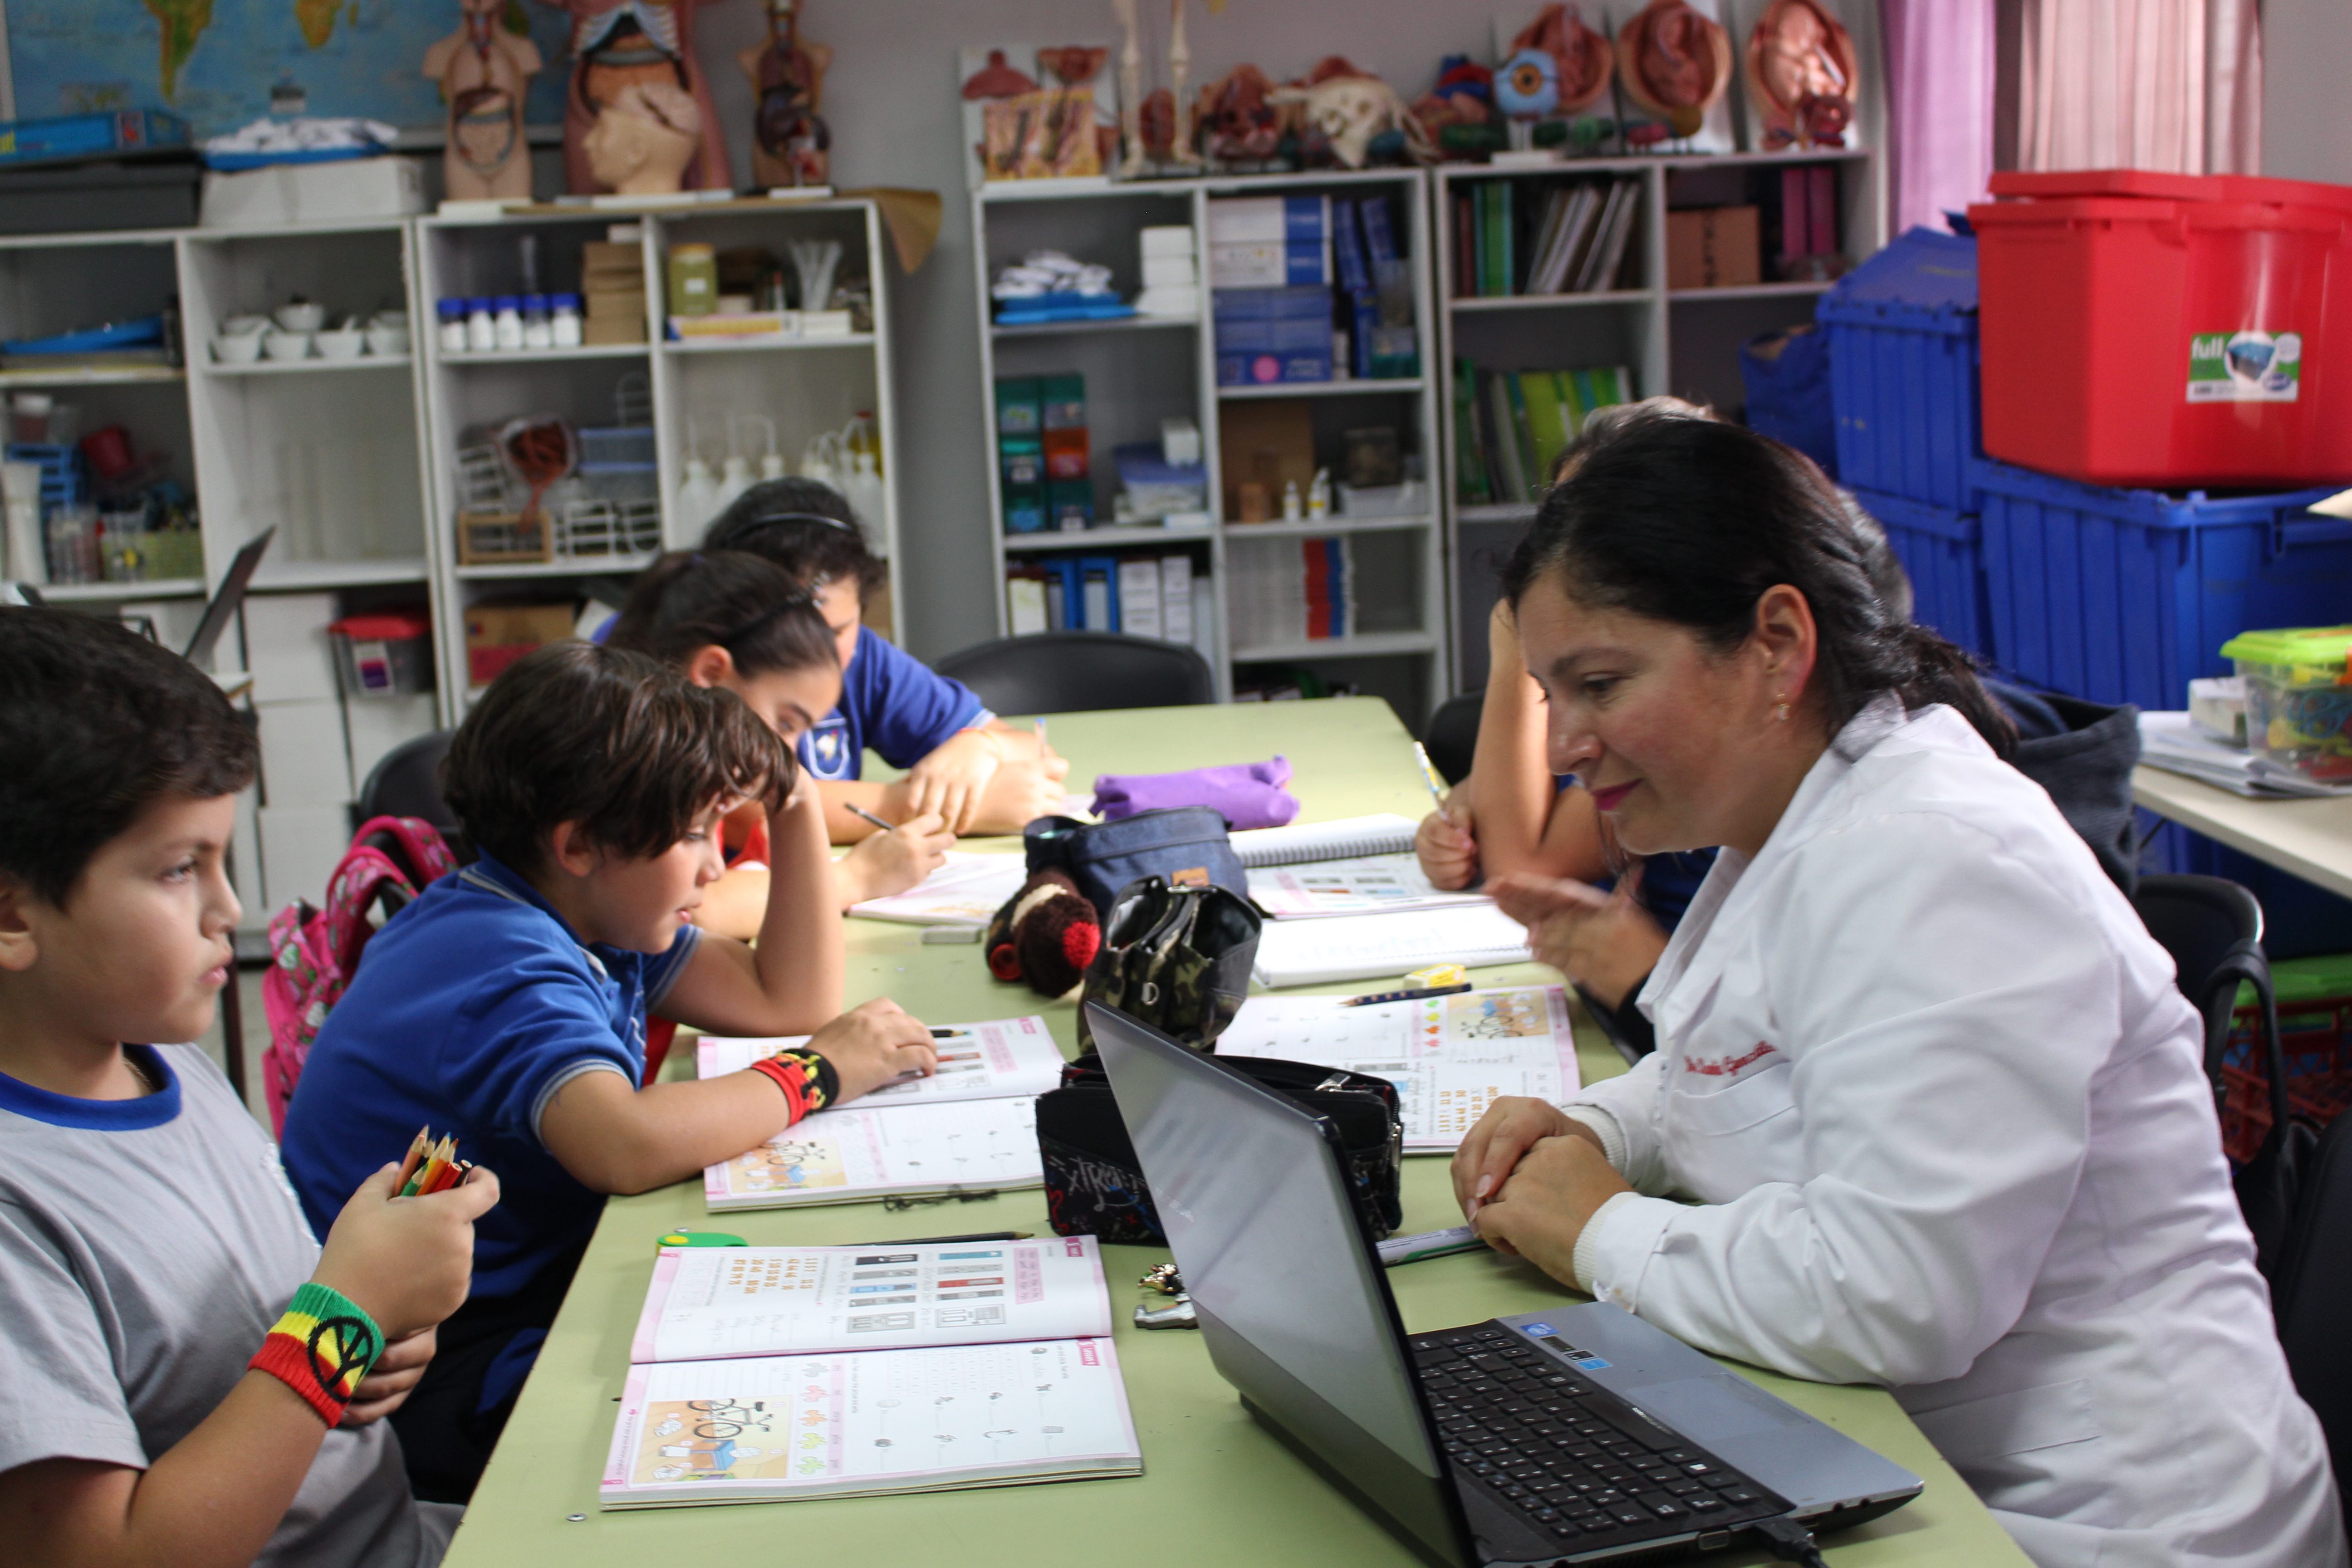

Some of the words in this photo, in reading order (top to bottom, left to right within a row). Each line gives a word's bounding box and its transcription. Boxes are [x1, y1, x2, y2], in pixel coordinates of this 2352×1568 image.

[2191, 336, 2224, 359] full
[1487, 1086, 1498, 1097] 100
[1082, 1348, 1095, 1361] Lesson
